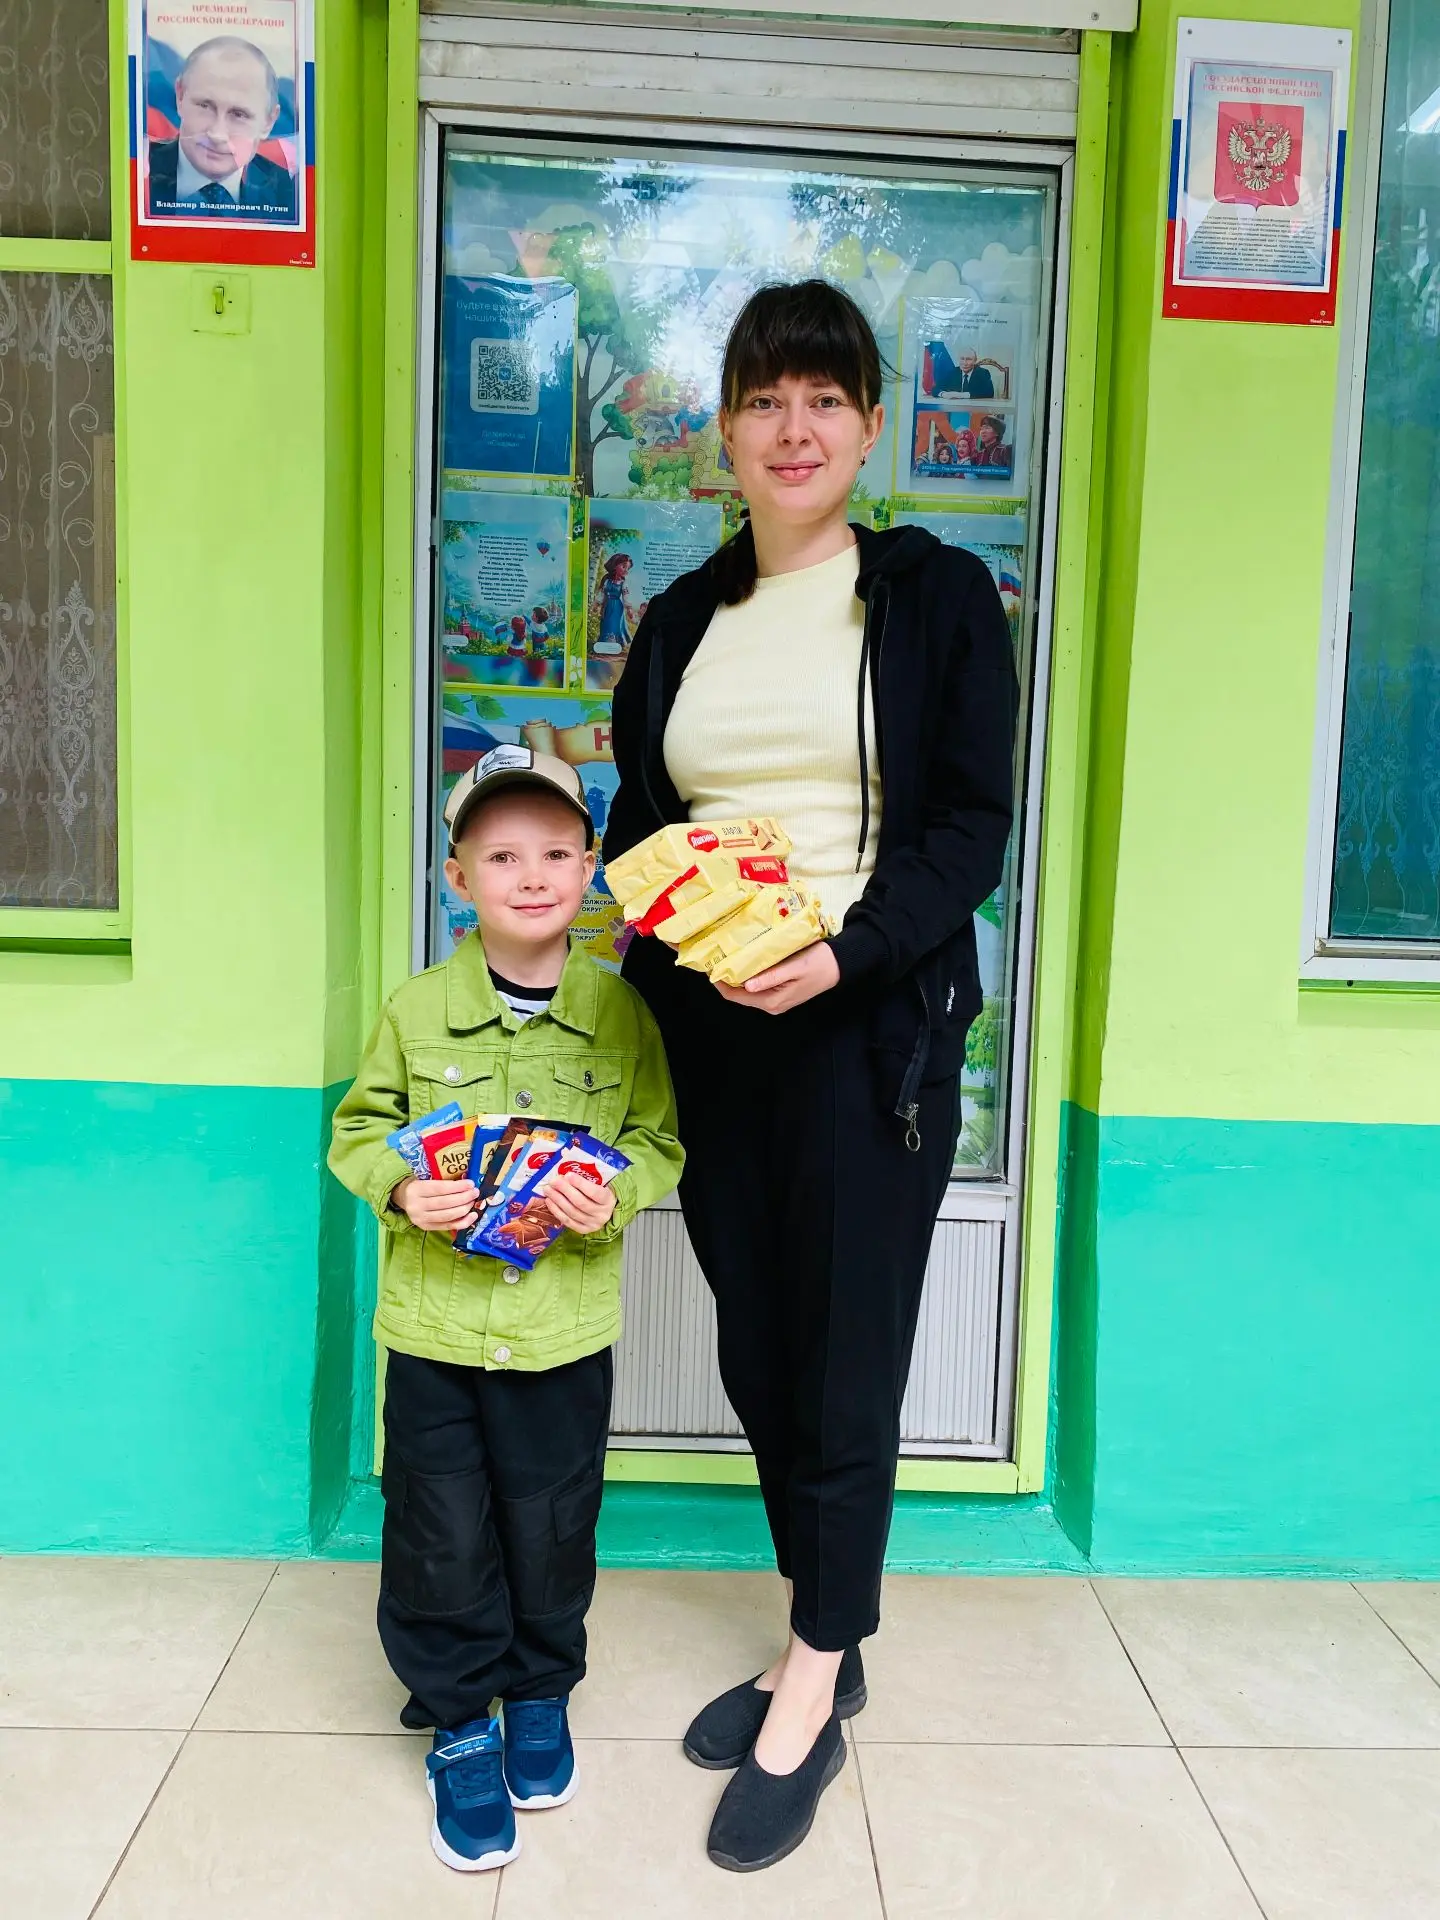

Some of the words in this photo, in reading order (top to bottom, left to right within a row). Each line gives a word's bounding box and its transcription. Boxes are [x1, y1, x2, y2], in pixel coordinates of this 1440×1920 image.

[155, 200, 197, 210] Владимир
[199, 201, 261, 211] Владимирович
[263, 204, 289, 213] Путин
[580, 898, 617, 906] ВОЛЖСКИЙ
[441, 1150, 472, 1166] Alpe
[446, 1163, 468, 1175] Go
